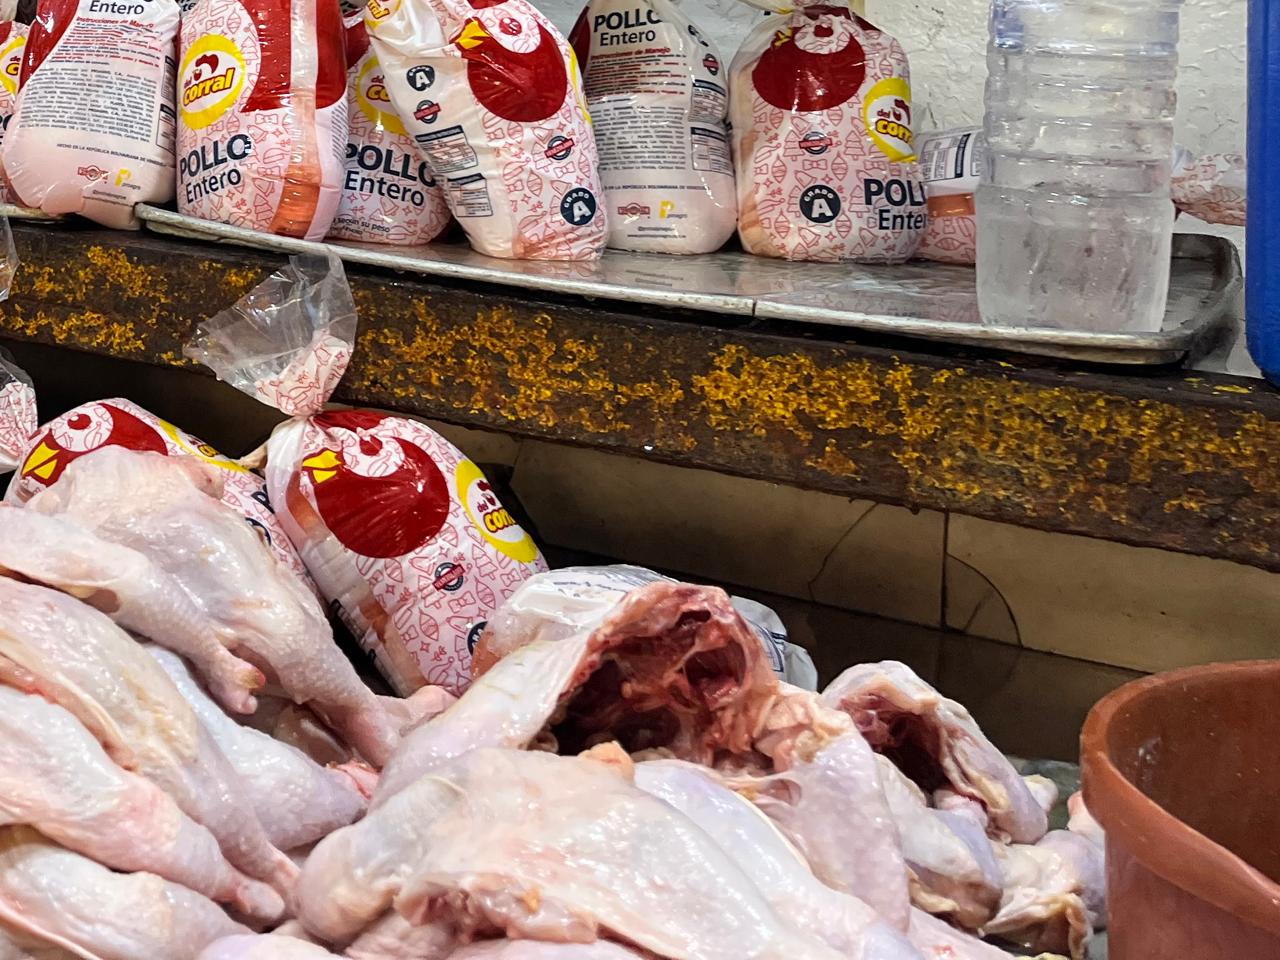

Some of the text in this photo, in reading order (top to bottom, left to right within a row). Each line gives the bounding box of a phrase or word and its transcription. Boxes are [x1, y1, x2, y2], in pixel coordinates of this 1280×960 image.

[89, 0, 145, 15] Entero
[593, 8, 663, 33] POLLO
[599, 30, 656, 47] Entero
[182, 68, 236, 108] corral
[179, 133, 253, 184] POLLO
[186, 168, 242, 205] Entero
[344, 170, 425, 207] Entero
[804, 188, 834, 202] GRADO
[564, 191, 590, 208] GRADO
[811, 198, 834, 218] A
[573, 200, 592, 222] A
[476, 500, 490, 513] del
